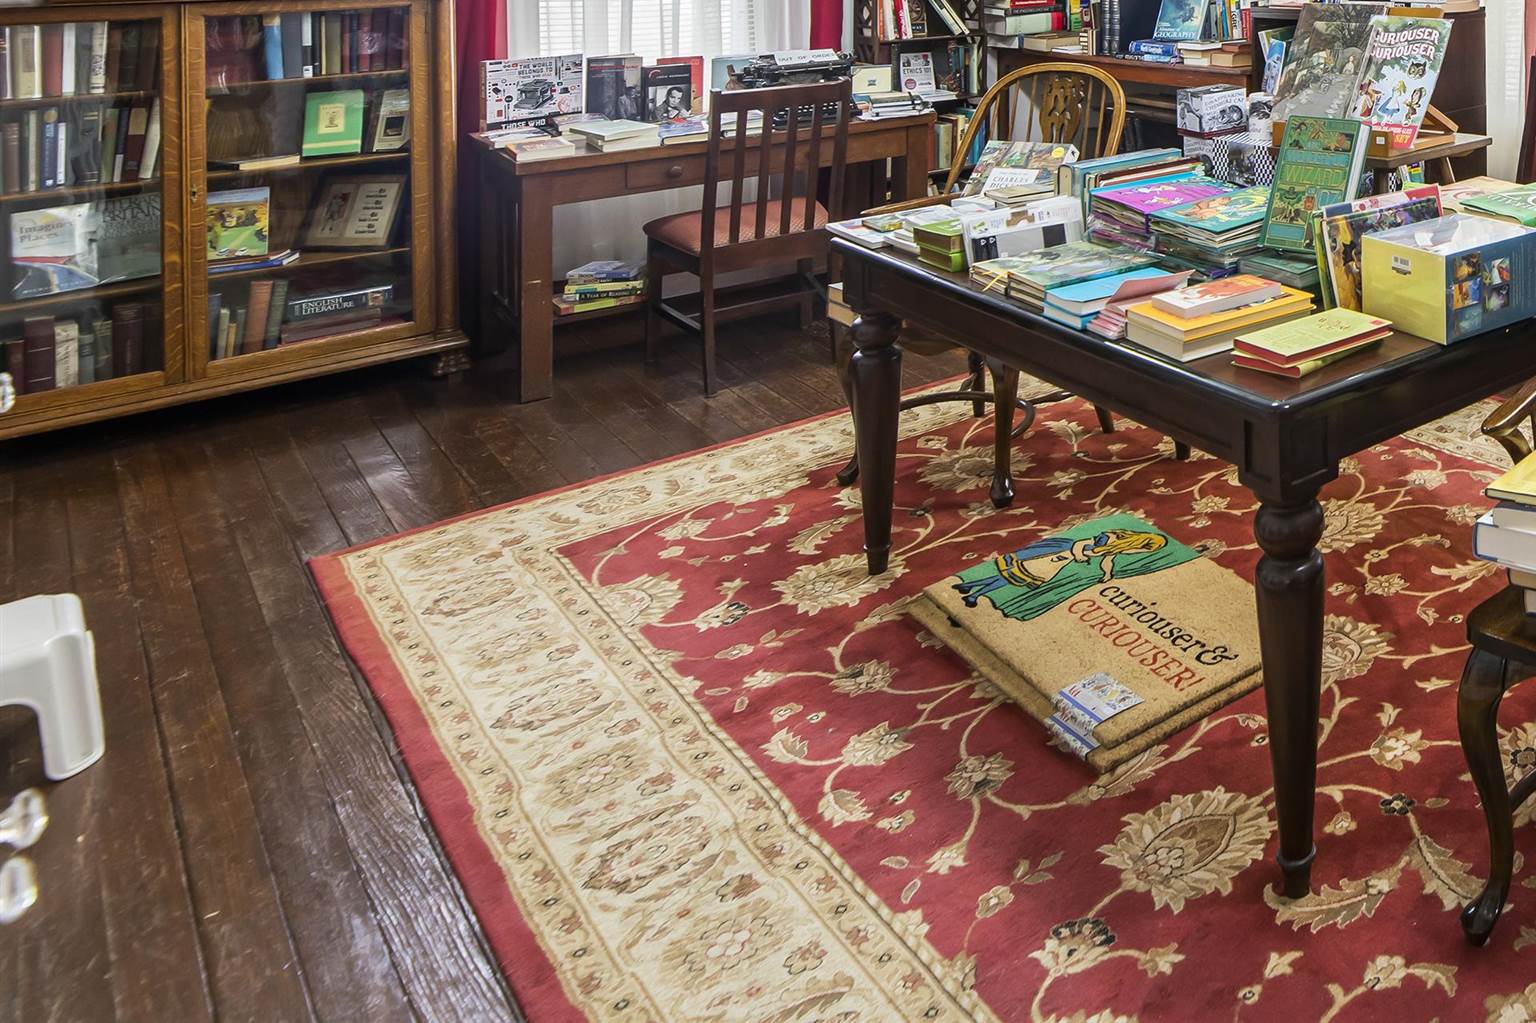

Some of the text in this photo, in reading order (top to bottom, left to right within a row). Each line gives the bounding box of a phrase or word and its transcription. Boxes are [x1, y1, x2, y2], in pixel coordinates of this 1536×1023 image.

[1153, 30, 1196, 39] GEOGRAPHY
[1374, 26, 1441, 46] CURIOUSER
[1369, 42, 1436, 61] CURIOUSER
[518, 67, 544, 75] BELONGS
[519, 61, 553, 71] THE WORLD
[902, 66, 932, 76] ETHICS 101
[500, 118, 547, 130] THOSE WHO
[1394, 134, 1411, 144] SET
[19, 232, 58, 244] Places
[301, 297, 343, 310] ENGLISH
[301, 300, 355, 316] LITERATURE
[1098, 584, 1207, 654] curiouser
[1068, 598, 1206, 692] CURIOUSER!
